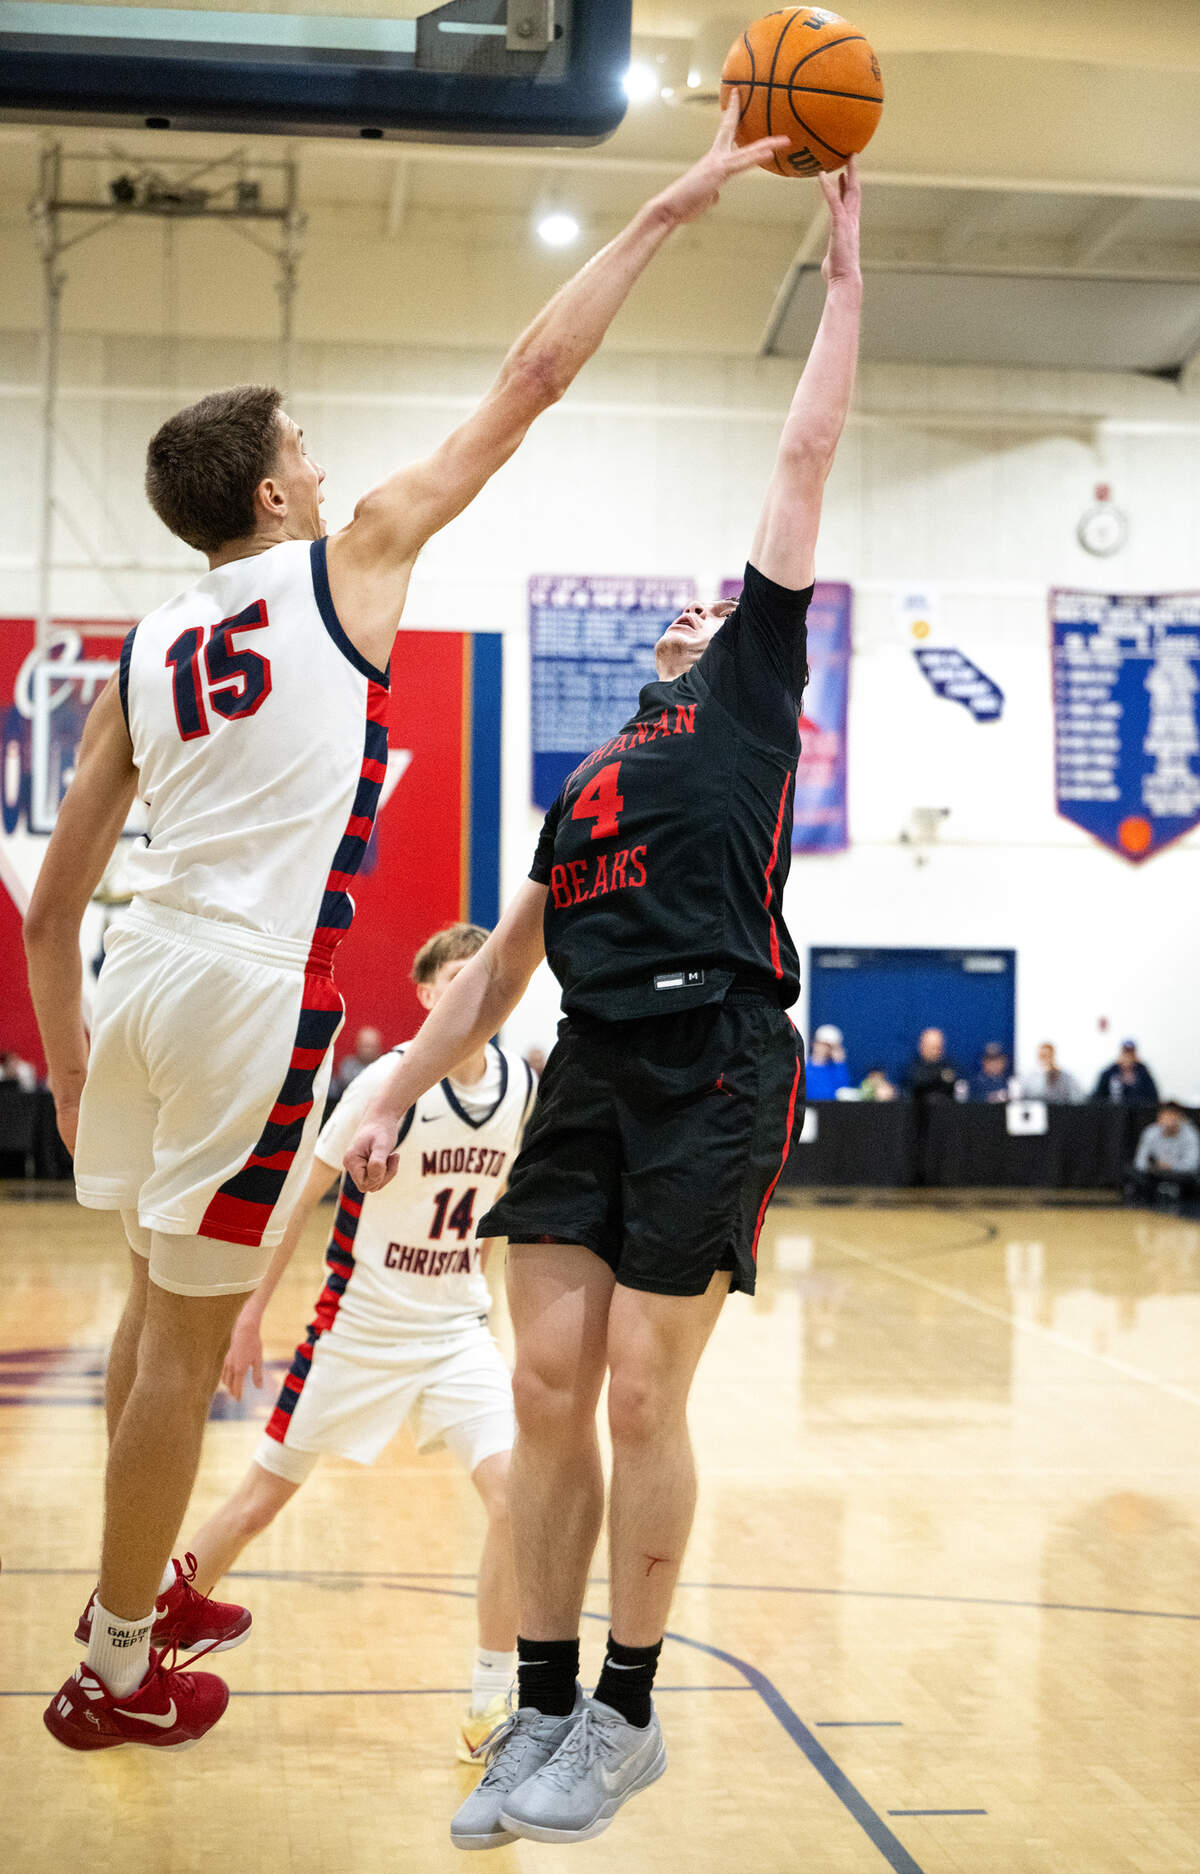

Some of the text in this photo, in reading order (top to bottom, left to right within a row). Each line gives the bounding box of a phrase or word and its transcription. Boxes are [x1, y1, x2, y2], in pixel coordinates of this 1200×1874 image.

[165, 598, 273, 742] 15
[563, 703, 698, 792] HANAN
[571, 760, 623, 840] 4
[551, 845, 647, 909] BEARS
[688, 971, 698, 981] M
[421, 1147, 506, 1178] MODESTO
[428, 1186, 478, 1240] 14
[384, 1241, 480, 1277] CHRISTA
[107, 1626, 151, 1639] GALLER
[112, 1636, 145, 1648] DEPT
